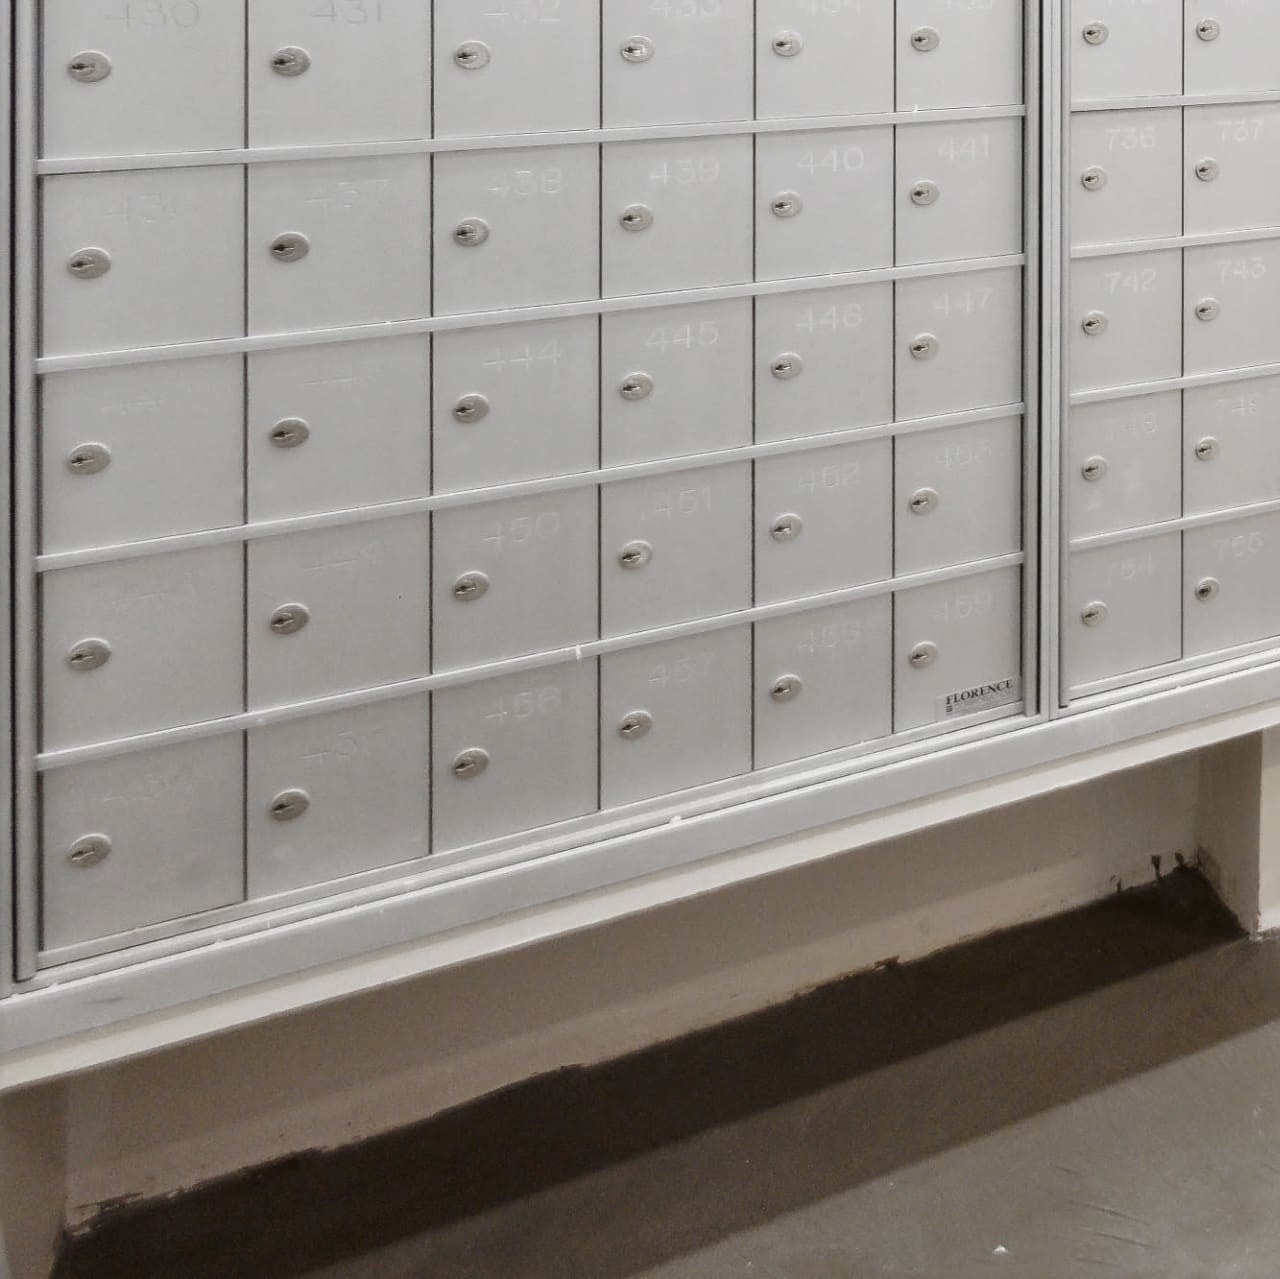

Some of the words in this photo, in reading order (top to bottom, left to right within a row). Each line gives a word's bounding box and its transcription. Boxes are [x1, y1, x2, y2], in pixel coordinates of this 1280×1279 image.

[311, 0, 382, 25] 431
[1105, 128, 1156, 151] 736
[1217, 120, 1264, 142] 737
[796, 147, 863, 175] 440
[937, 136, 989, 161] 441
[648, 158, 720, 186] 439
[1105, 270, 1156, 295] 742
[1217, 258, 1265, 282] 743
[795, 304, 862, 333] 446
[645, 323, 718, 352] 445
[945, 679, 1014, 705] FLORENCE
